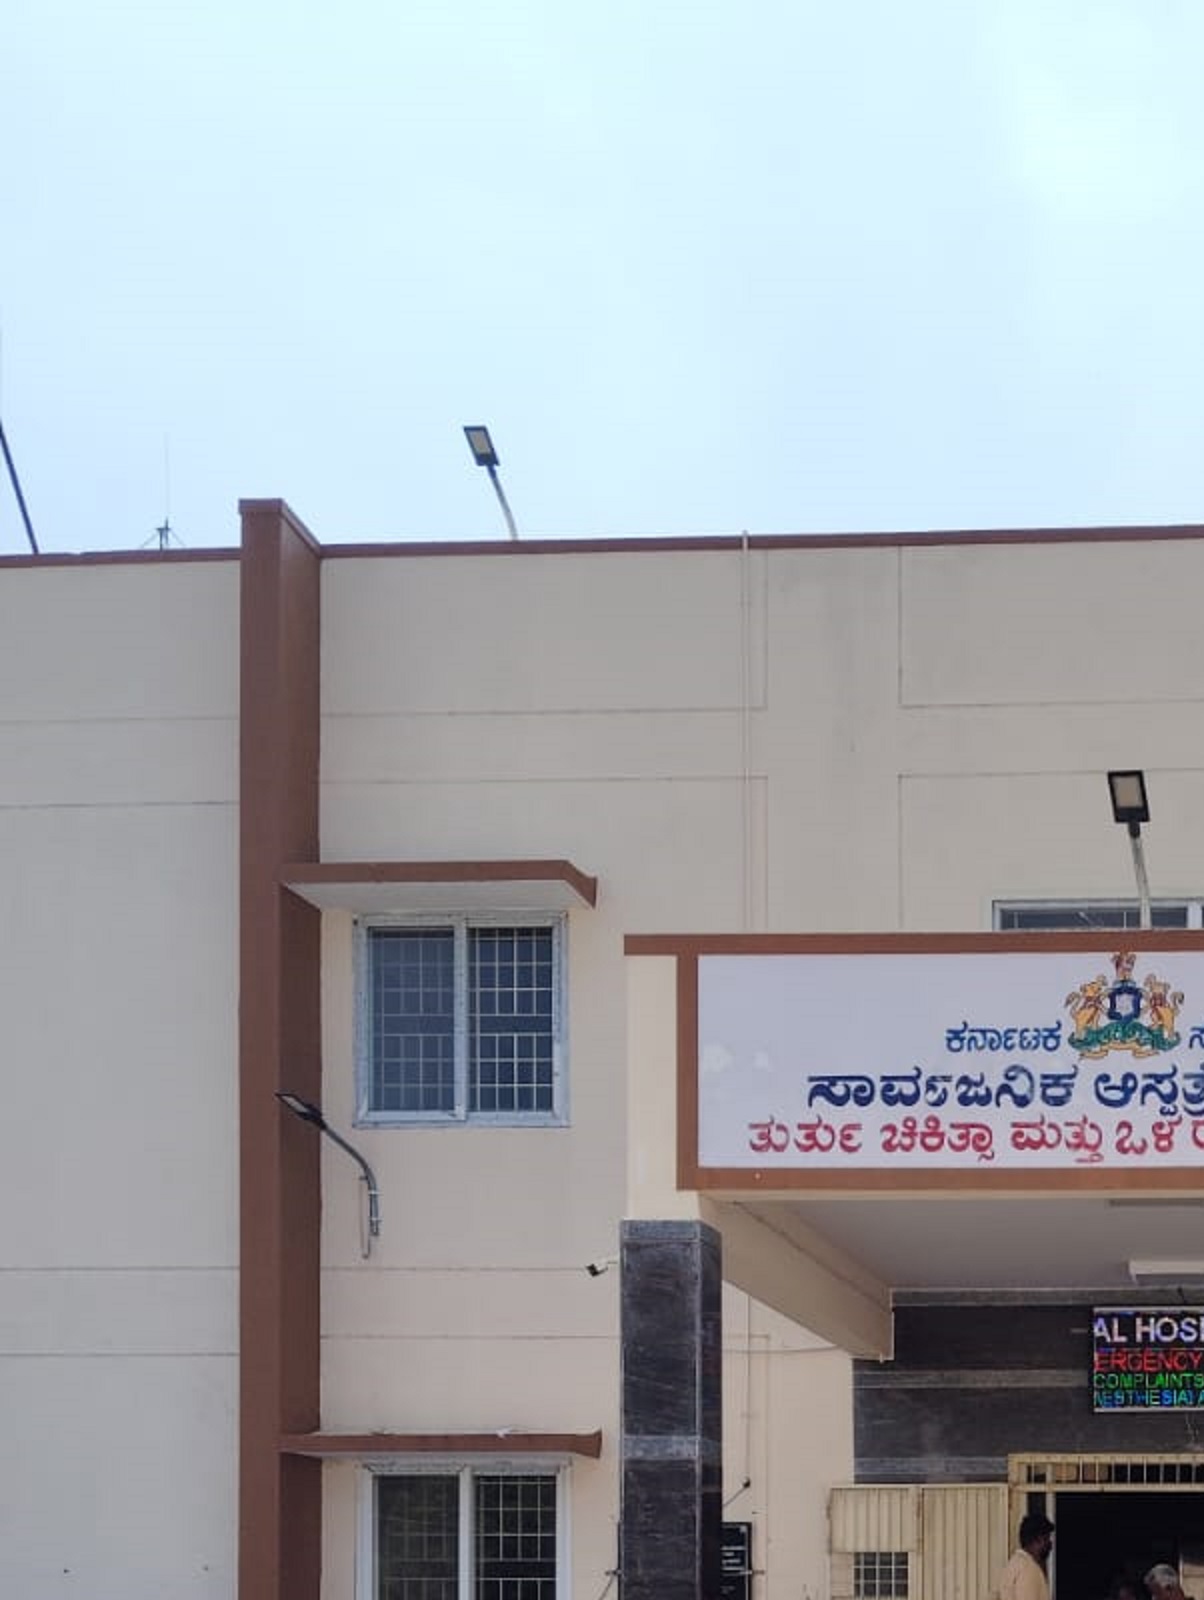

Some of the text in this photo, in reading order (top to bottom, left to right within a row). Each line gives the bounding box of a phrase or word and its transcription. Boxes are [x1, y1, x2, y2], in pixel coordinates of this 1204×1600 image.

[945, 1020, 1062, 1053] ಕರ್ನಾಟಕ
[807, 1065, 1079, 1108] ಸಾರ್ವಜನಿಕ
[748, 1115, 862, 1154] ತುರ್ತು
[880, 1115, 995, 1161] ಚಿಕಿತ್ಸಾ
[1010, 1114, 1104, 1163] ಮತ್ತು
[1094, 1315, 1127, 1343] AL
